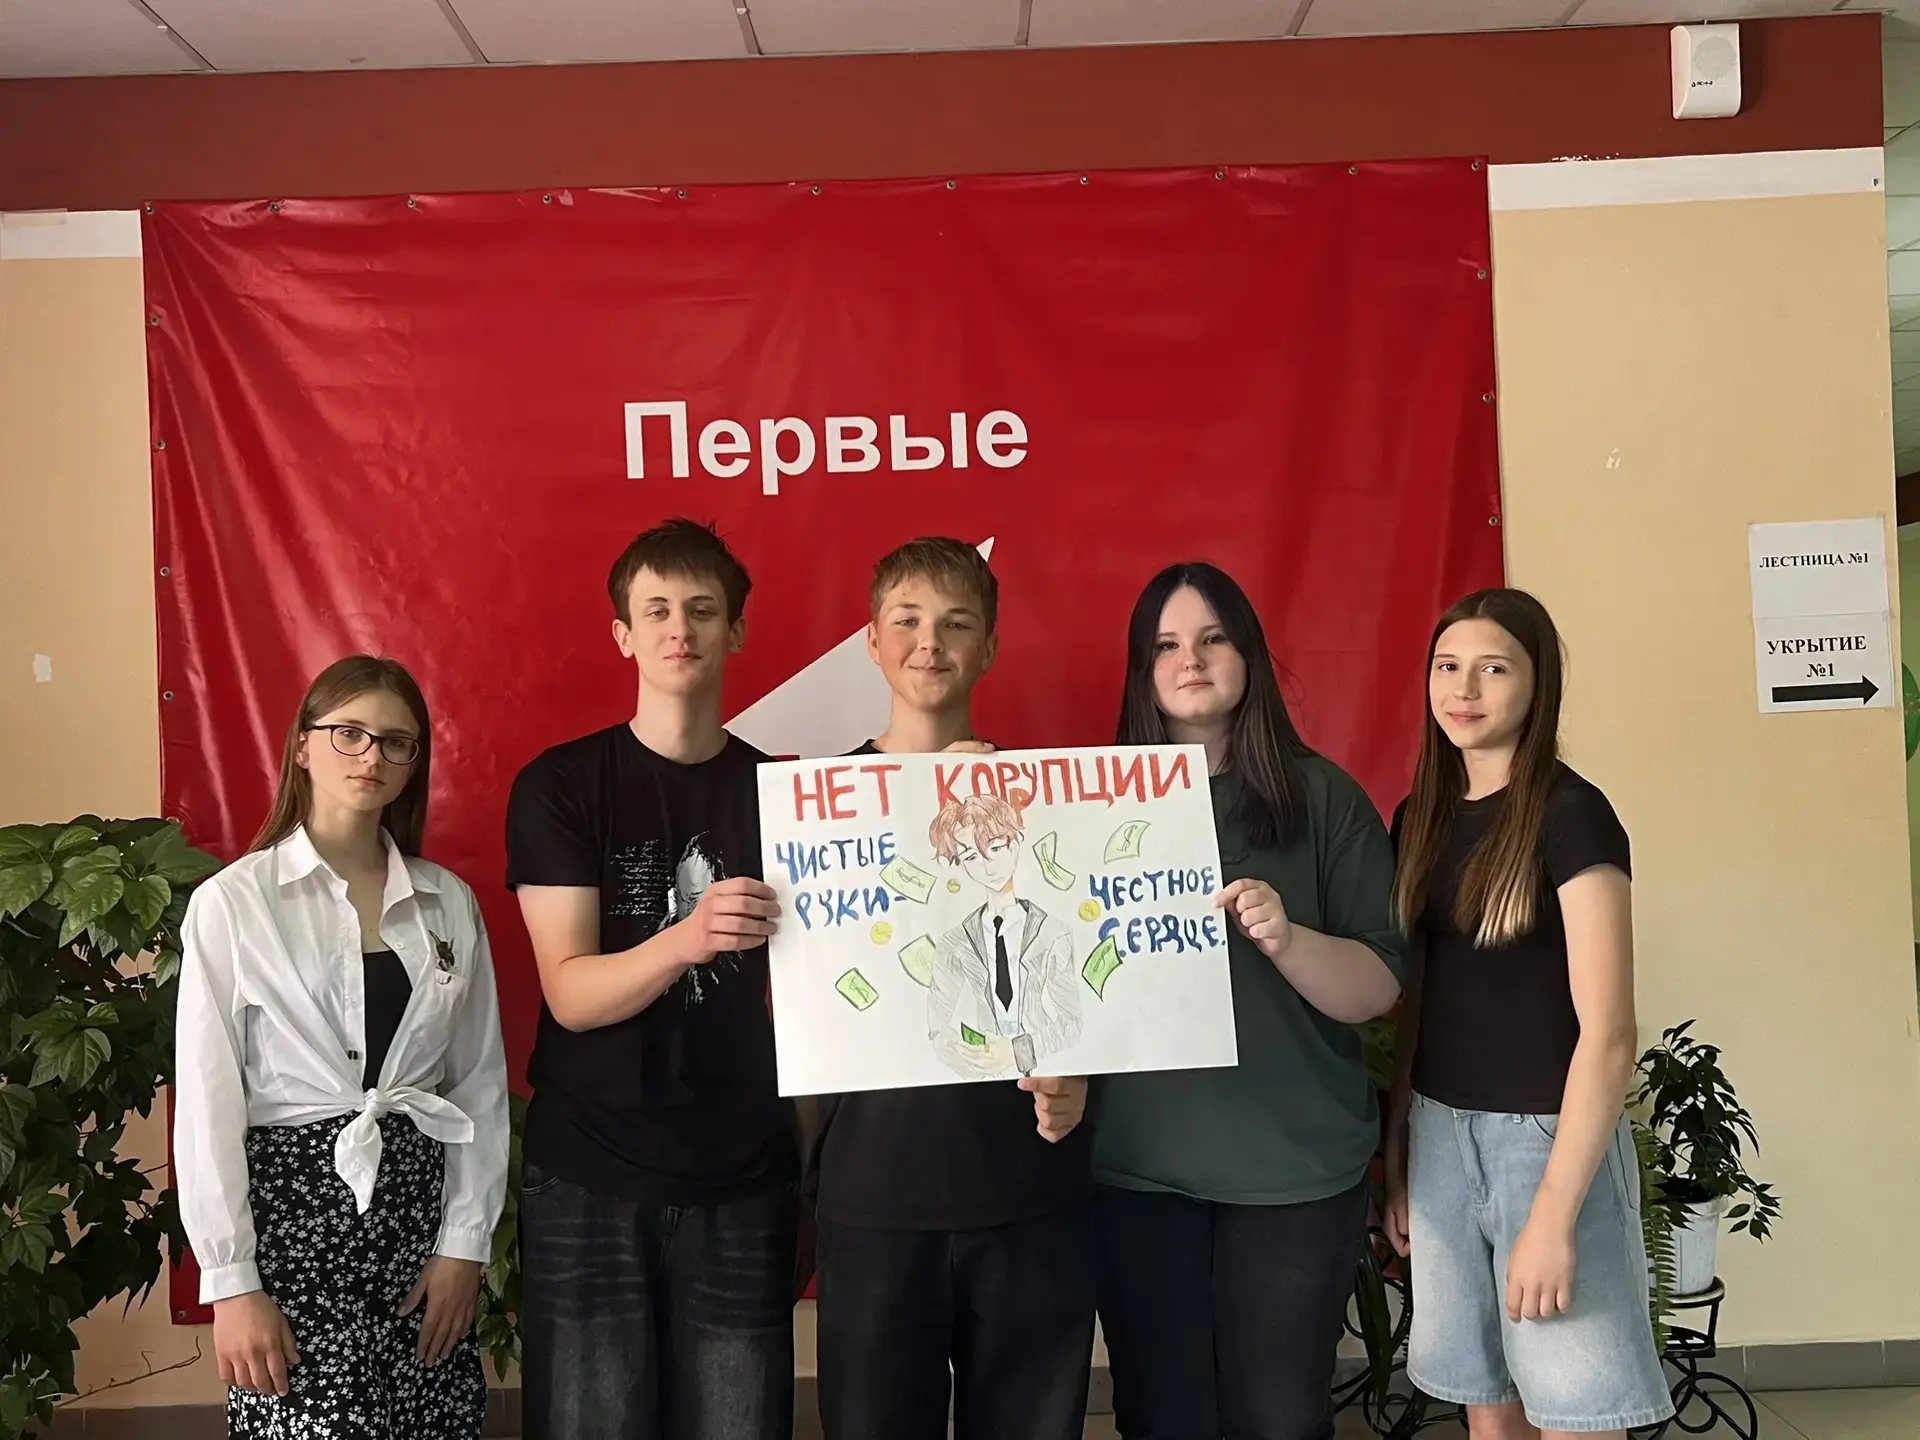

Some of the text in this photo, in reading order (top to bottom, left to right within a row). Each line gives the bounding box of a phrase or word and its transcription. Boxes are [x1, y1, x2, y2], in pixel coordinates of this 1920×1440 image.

[624, 400, 1029, 496] Первые
[1758, 552, 1869, 568] ЛЕСТНИЦА №1
[1766, 635, 1867, 655] УКРЫТИЕ
[1806, 662, 1835, 678] №1
[793, 764, 902, 821] НЕТ
[775, 832, 896, 885] ЧИСТЫЕ
[1089, 866, 1216, 911] ЧЕСТНОЕ
